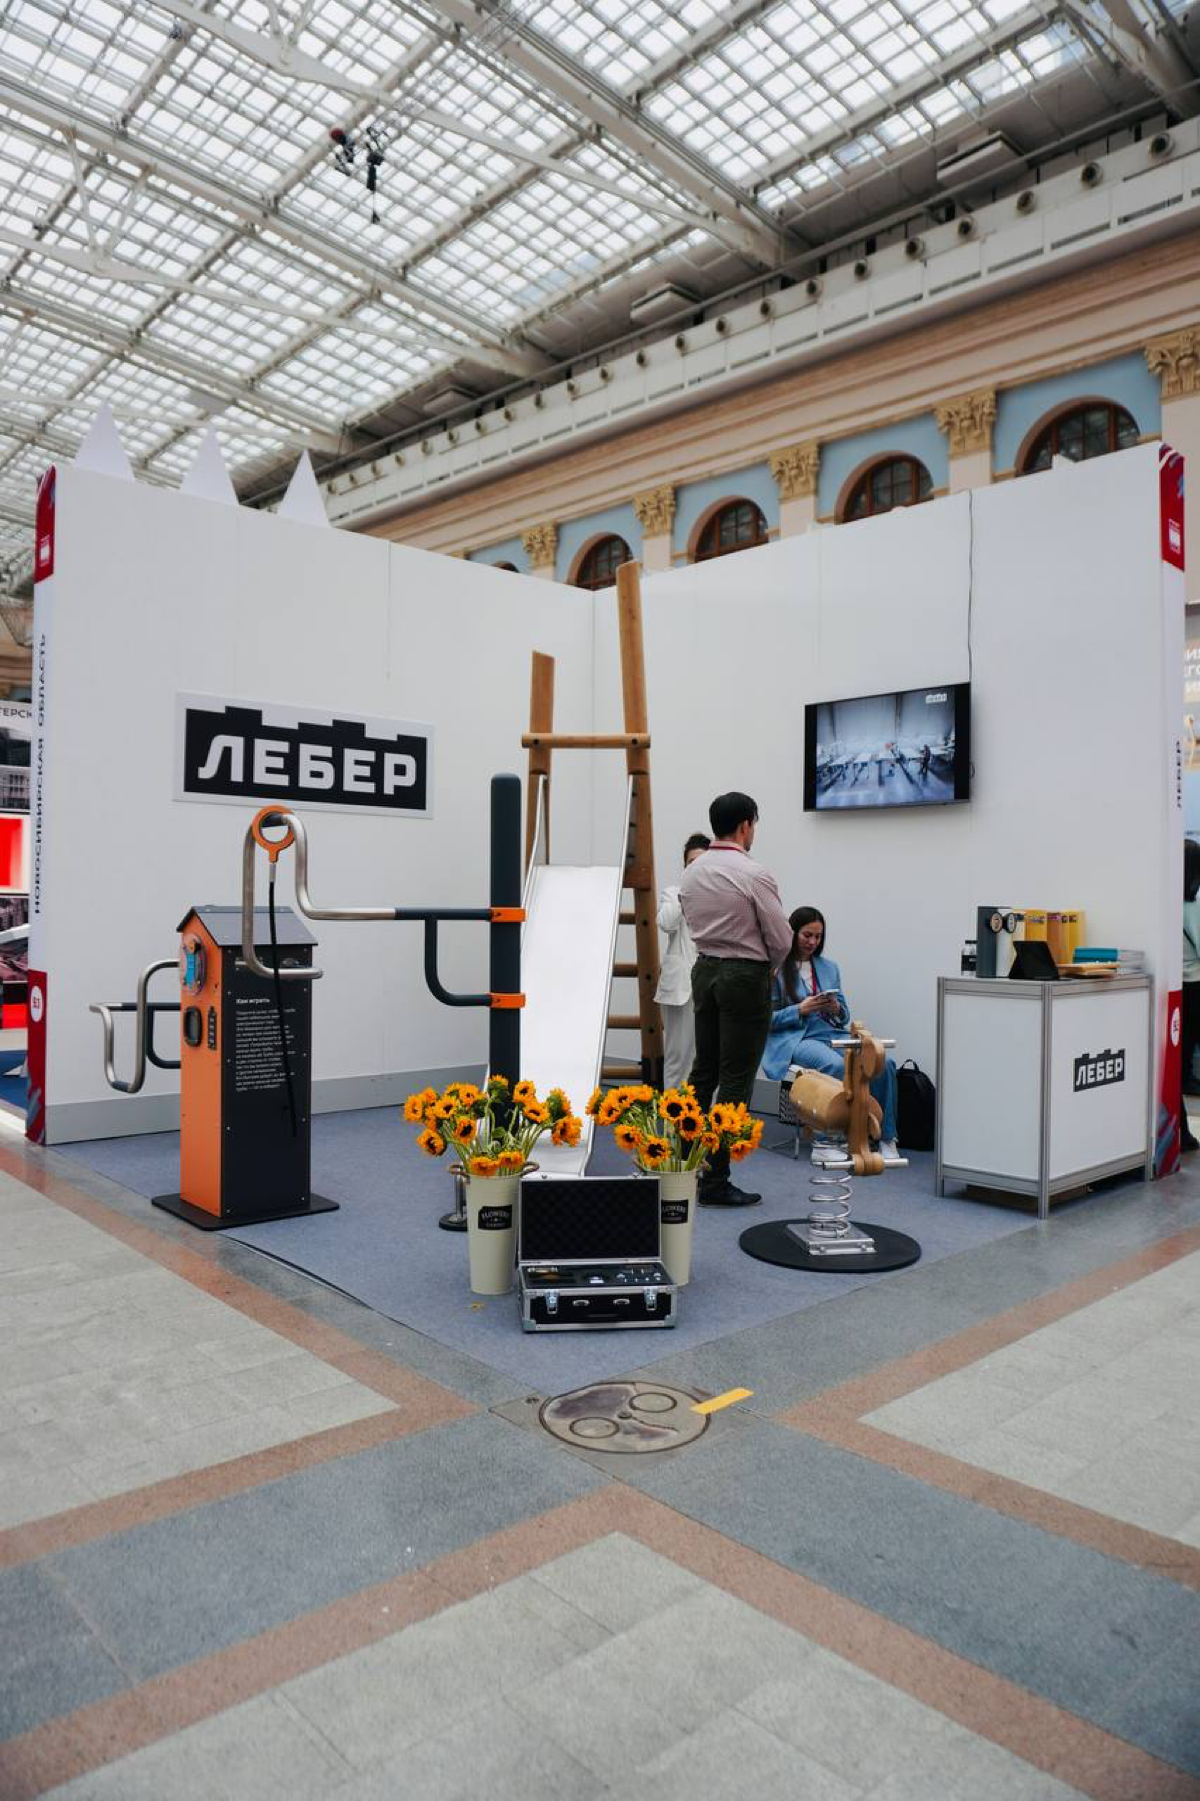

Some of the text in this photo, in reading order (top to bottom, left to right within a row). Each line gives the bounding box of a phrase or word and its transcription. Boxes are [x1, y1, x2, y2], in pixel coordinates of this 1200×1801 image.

[35, 633, 46, 914] НОВОСИБИРСКАЯ ОБЛАСТЬ
[197, 734, 417, 796] ЛЕБЕР
[1075, 1057, 1124, 1086] ЛЕБЕР
